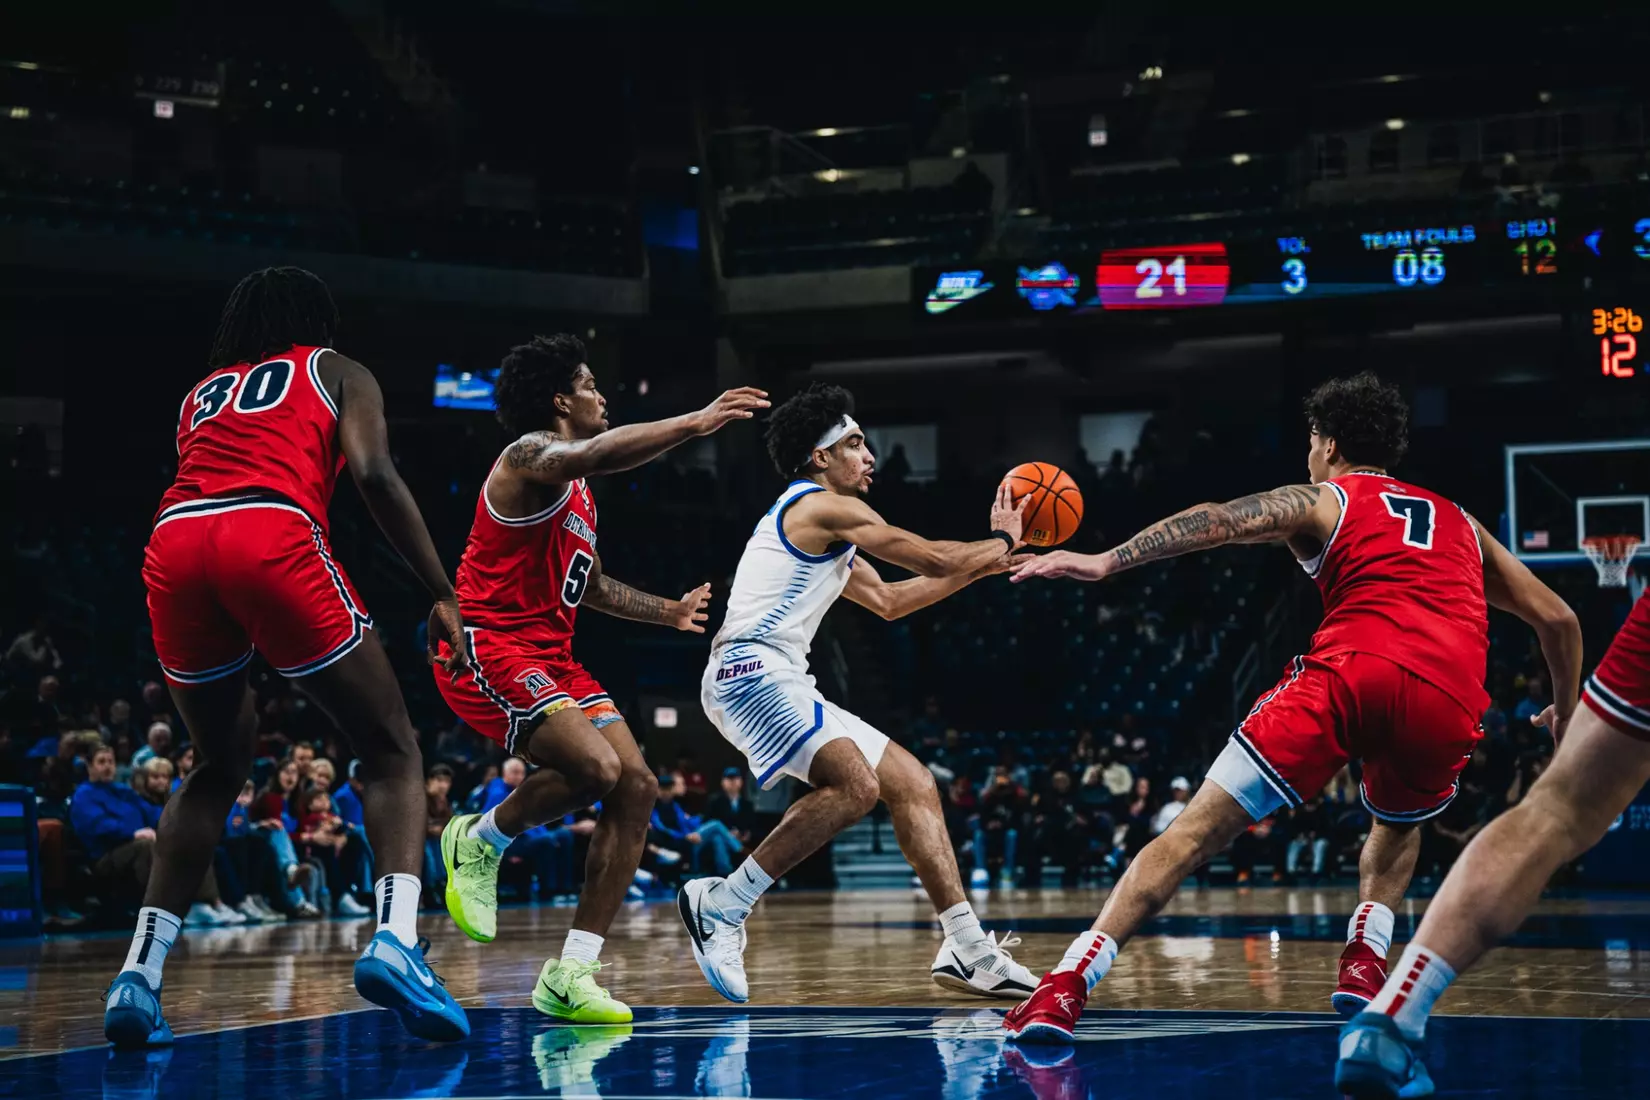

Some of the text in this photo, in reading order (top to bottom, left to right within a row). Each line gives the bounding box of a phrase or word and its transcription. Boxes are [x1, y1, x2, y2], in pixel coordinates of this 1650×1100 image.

[1135, 255, 1187, 299] 21
[1281, 258, 1307, 294] 3
[1393, 247, 1446, 287] 08
[1514, 240, 1557, 275] 12
[1592, 306, 1643, 335] 3:26
[1601, 333, 1637, 378] 12
[190, 359, 296, 433] 30
[1379, 491, 1436, 550] 7
[561, 549, 593, 608] 5
